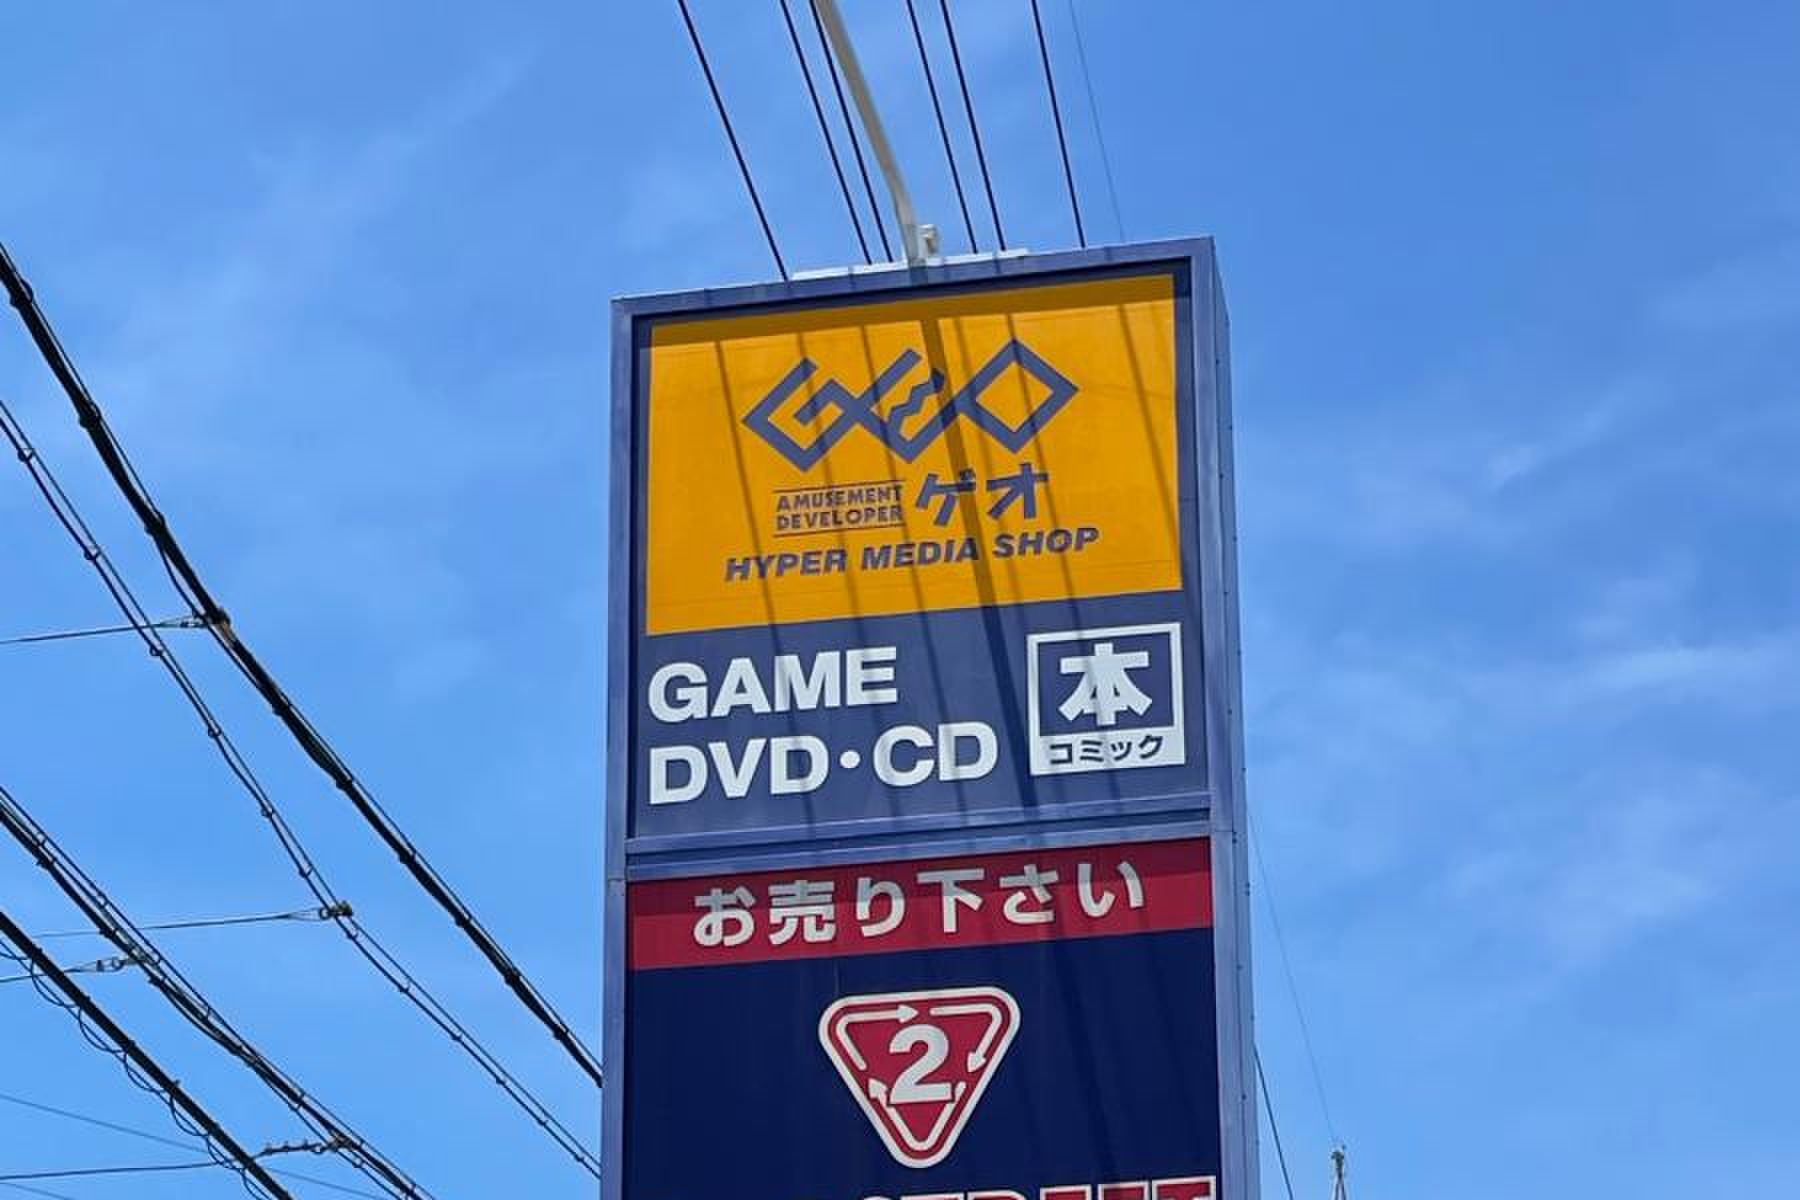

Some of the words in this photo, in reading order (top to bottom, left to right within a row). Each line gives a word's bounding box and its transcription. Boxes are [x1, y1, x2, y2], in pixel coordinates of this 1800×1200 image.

[776, 484, 904, 513] AMUSEMENT
[776, 505, 904, 531] DEVELOPER
[915, 462, 1050, 527] ゲオ
[724, 552, 848, 583] HYPER
[861, 537, 979, 570] MEDIA
[992, 527, 1100, 560] SHOP
[647, 646, 897, 723] GAME
[1058, 642, 1153, 726] 本
[1049, 733, 1164, 766] コミック
[692, 860, 1146, 947] お売り下さい
[889, 1022, 952, 1105] 2
